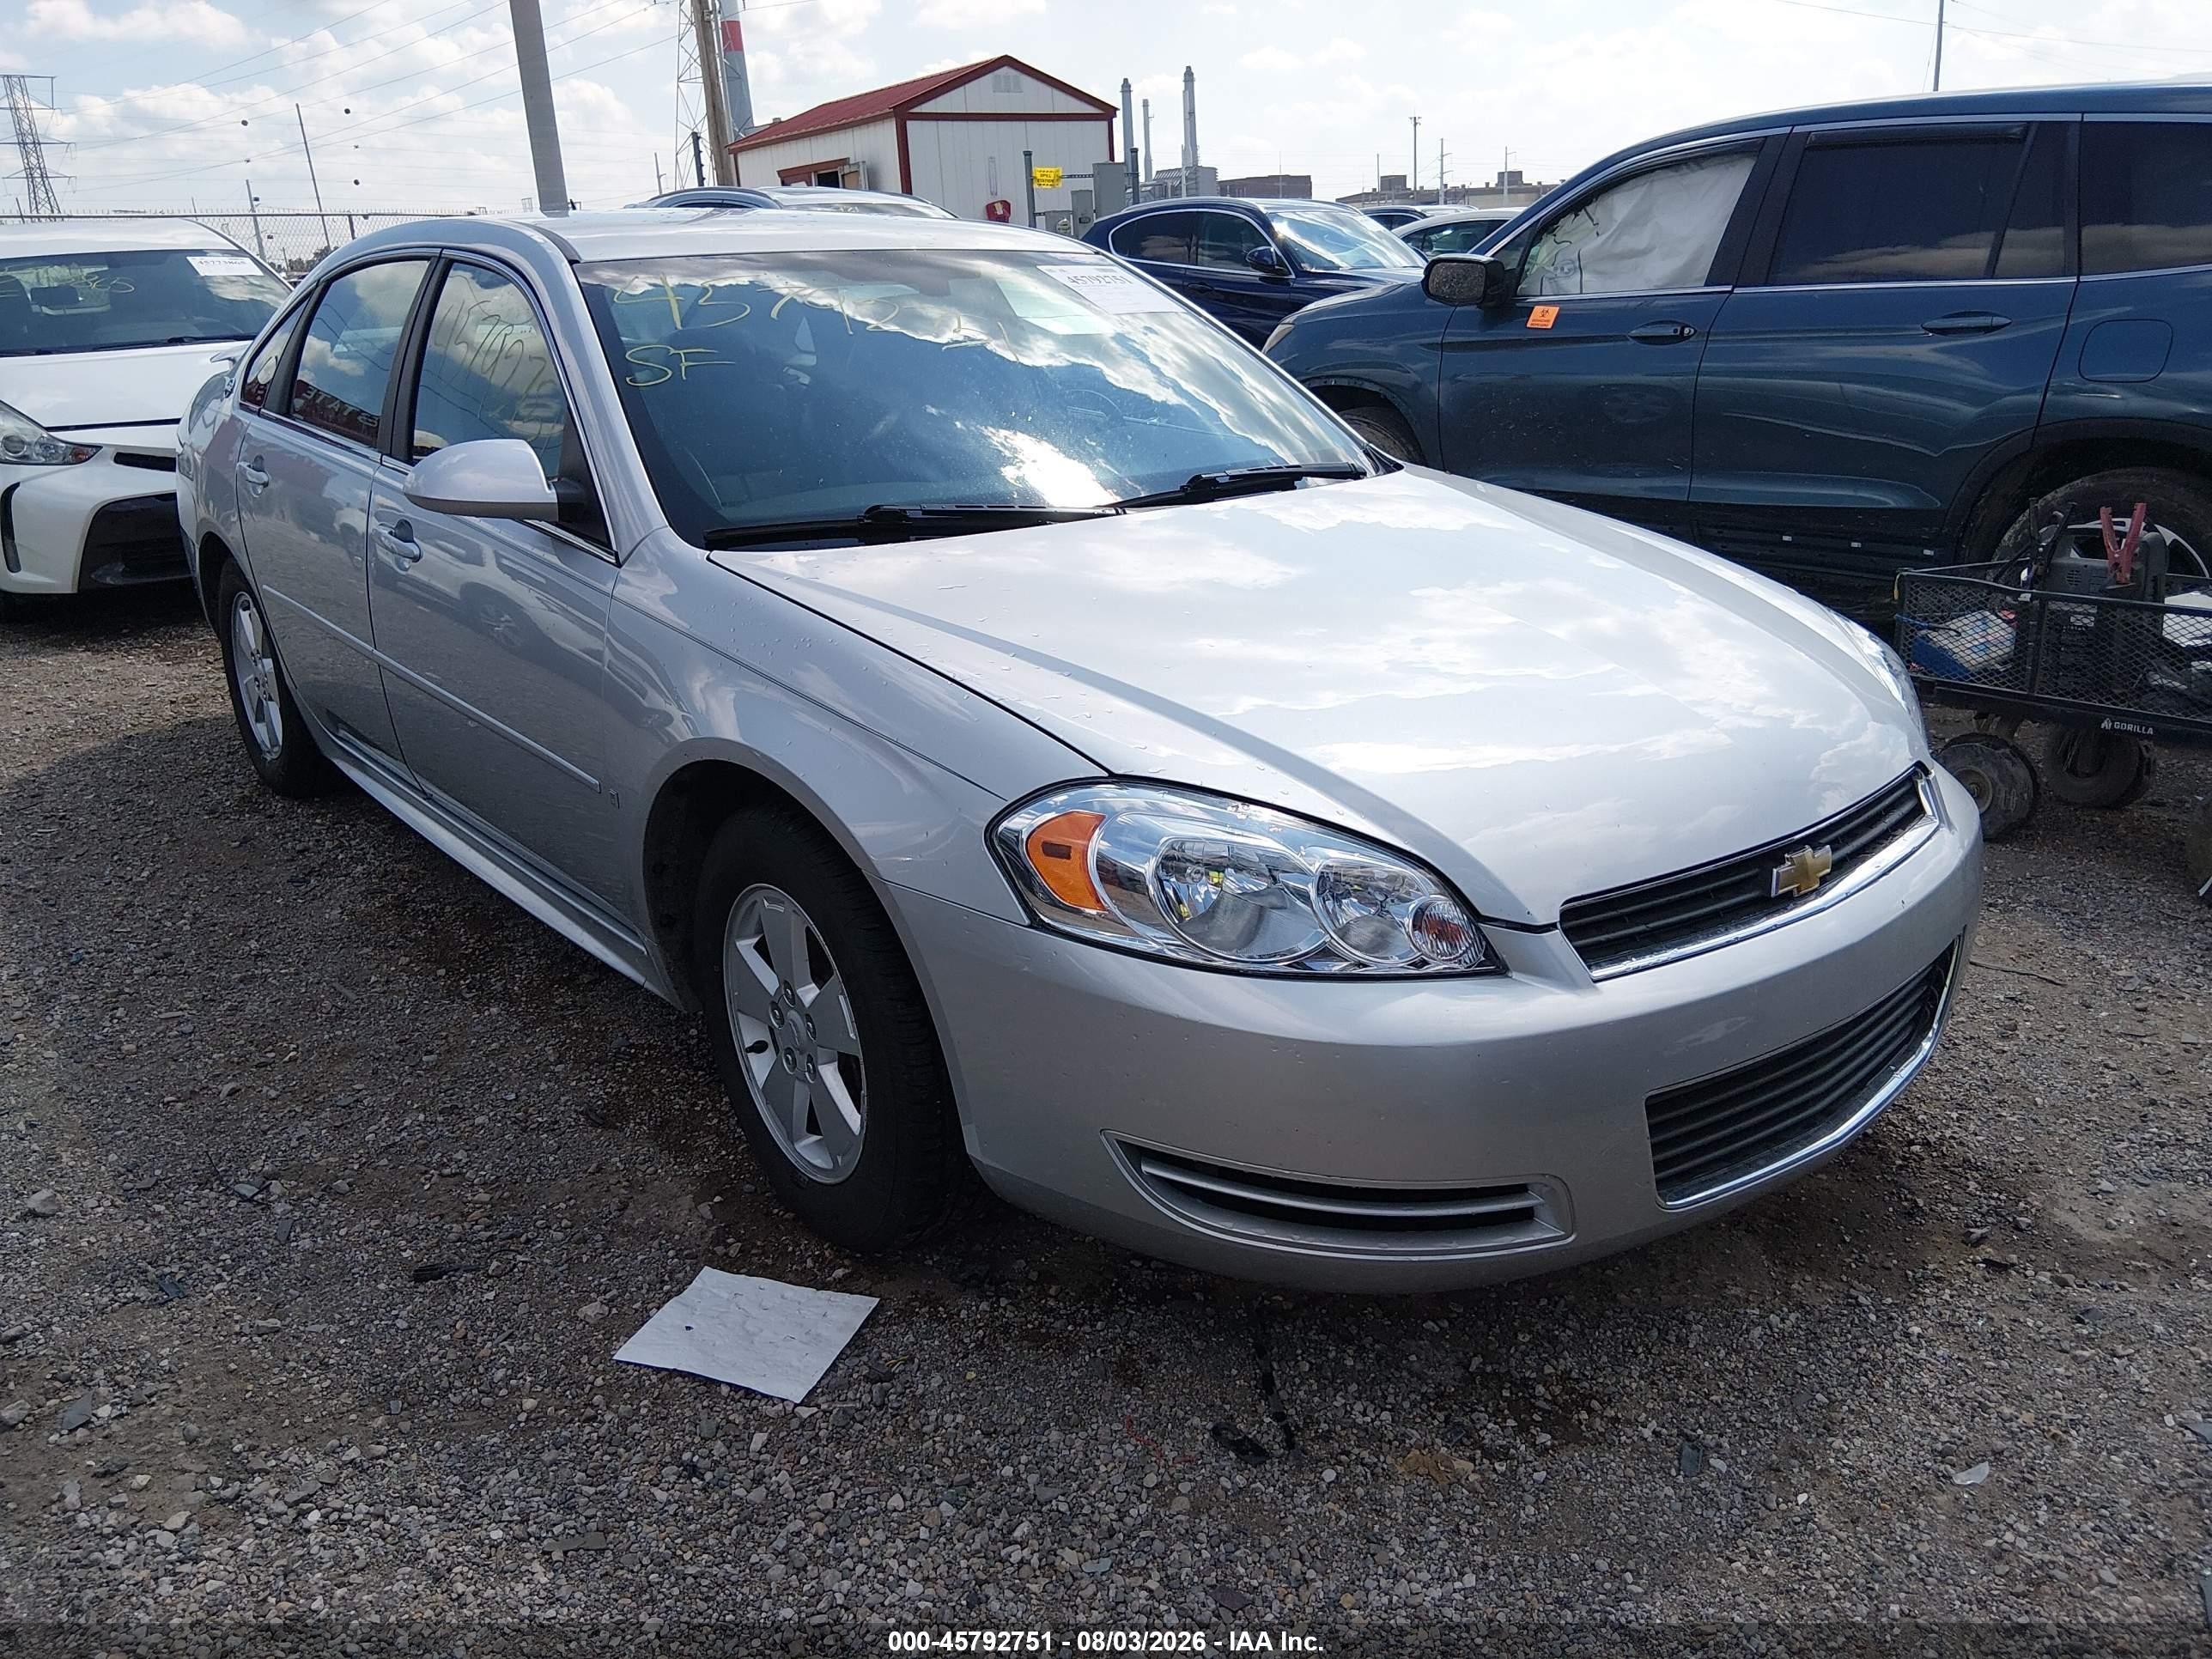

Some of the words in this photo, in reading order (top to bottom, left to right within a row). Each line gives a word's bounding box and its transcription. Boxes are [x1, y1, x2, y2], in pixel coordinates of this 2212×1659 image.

[1066, 275, 1133, 285] 45792751
[624, 343, 736, 387] SF
[2113, 721, 2154, 735] GORILLA
